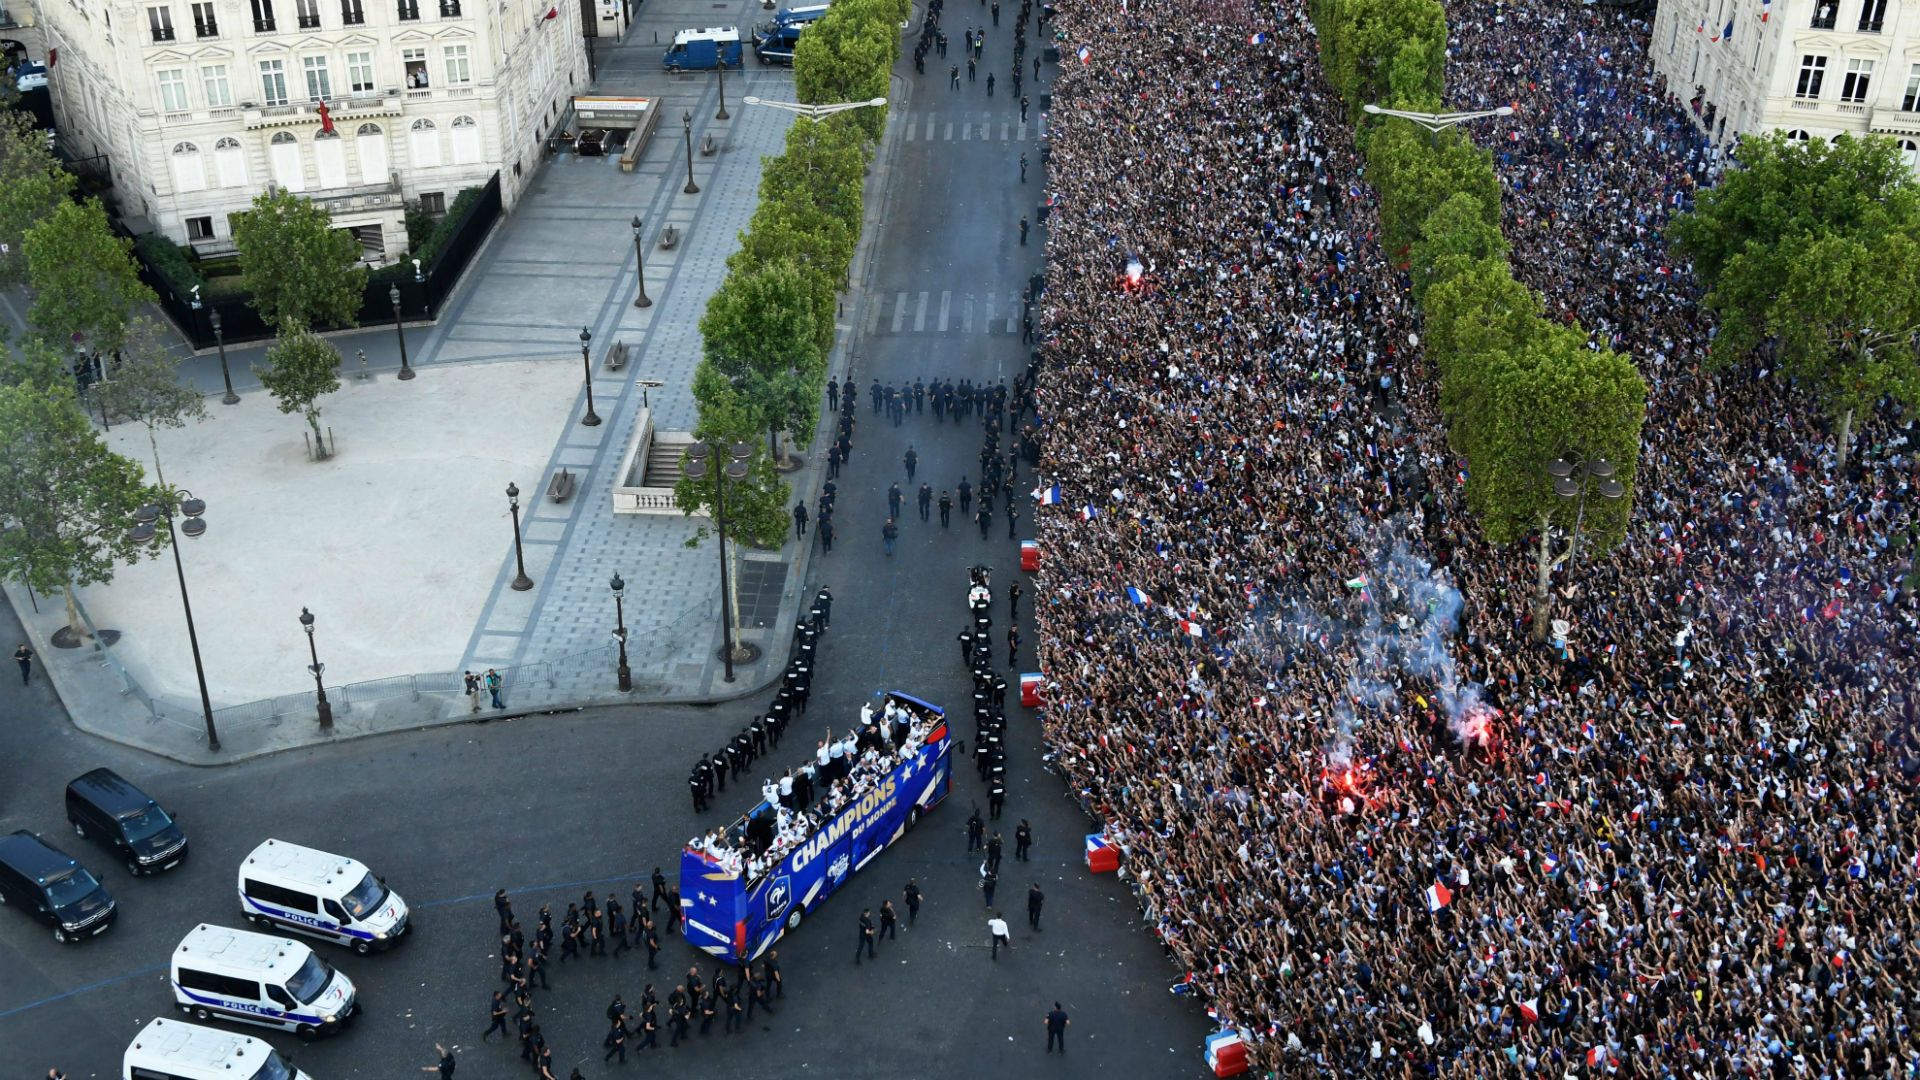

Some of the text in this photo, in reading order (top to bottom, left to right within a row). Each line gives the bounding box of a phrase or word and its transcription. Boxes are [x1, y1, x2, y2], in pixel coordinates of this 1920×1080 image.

[792, 775, 896, 872] CHAMPIONS
[852, 796, 897, 839] DU MONDE
[284, 912, 319, 926] POLICE
[223, 1001, 261, 1014] POLICE
